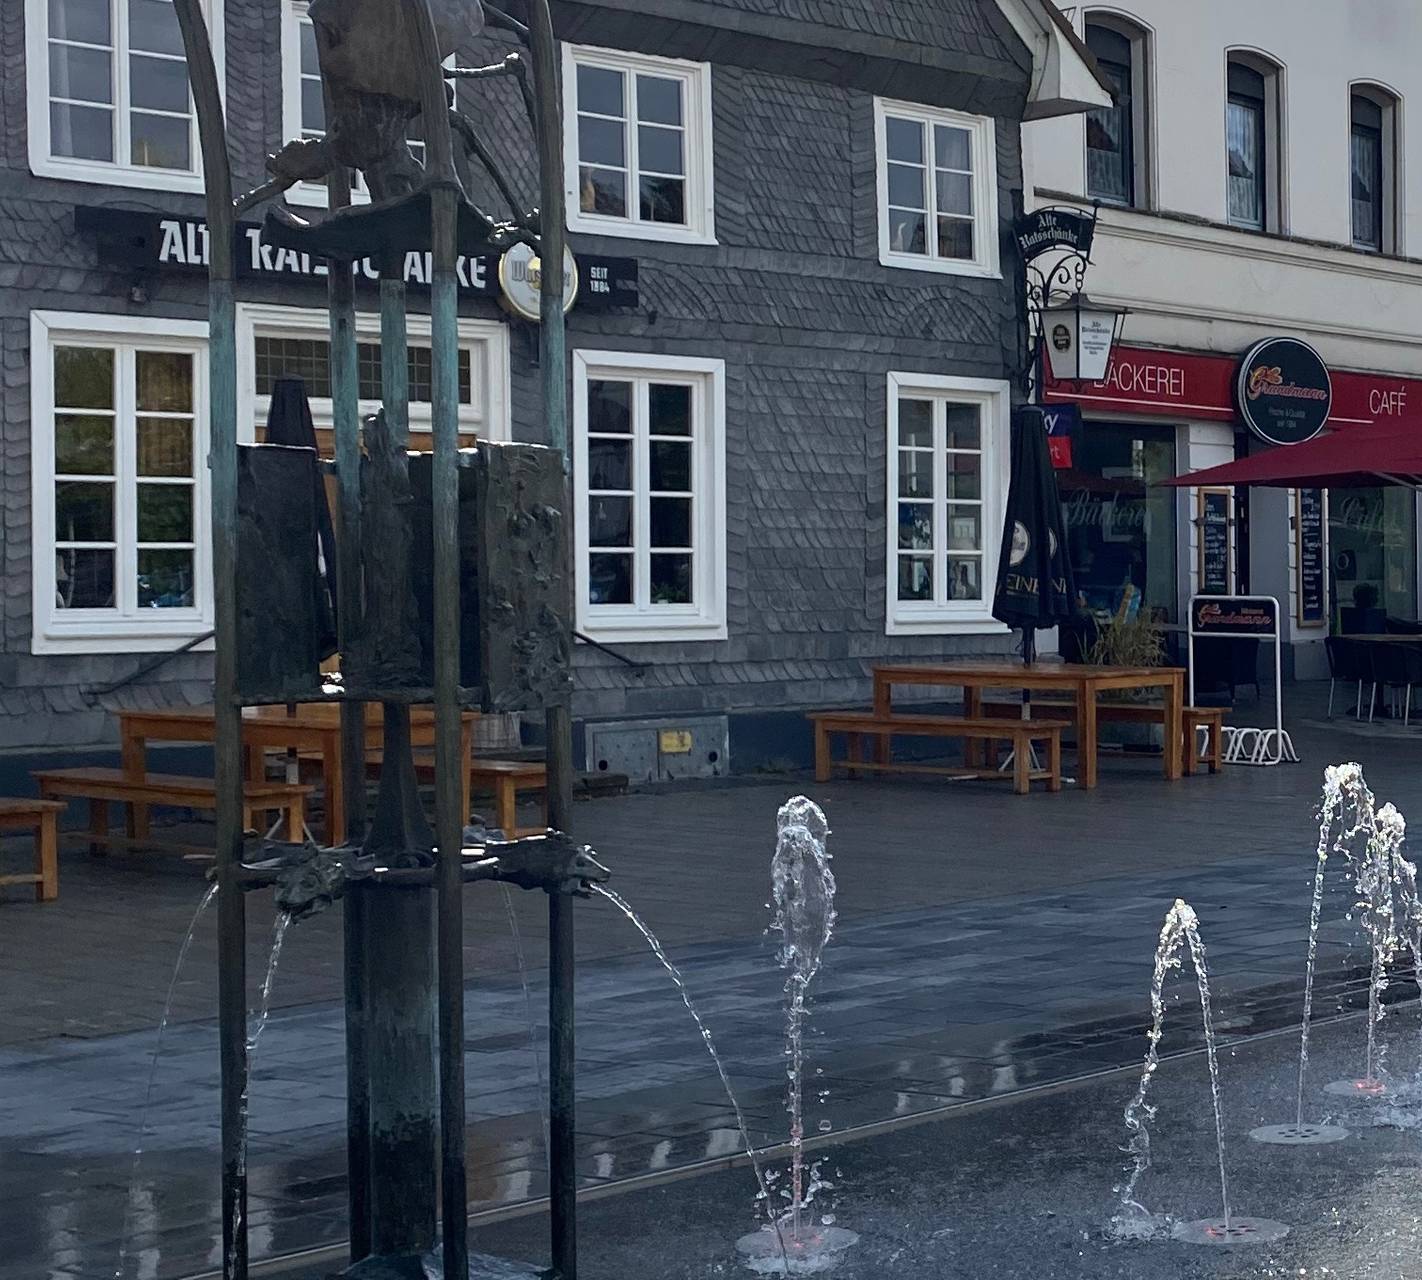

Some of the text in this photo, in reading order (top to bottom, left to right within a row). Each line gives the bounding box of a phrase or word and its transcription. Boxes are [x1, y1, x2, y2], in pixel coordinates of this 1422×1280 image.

[590, 266, 609, 280] SEIT
[1093, 355, 1185, 397] ÄCKEREI
[1369, 385, 1408, 417] CAFÉ
